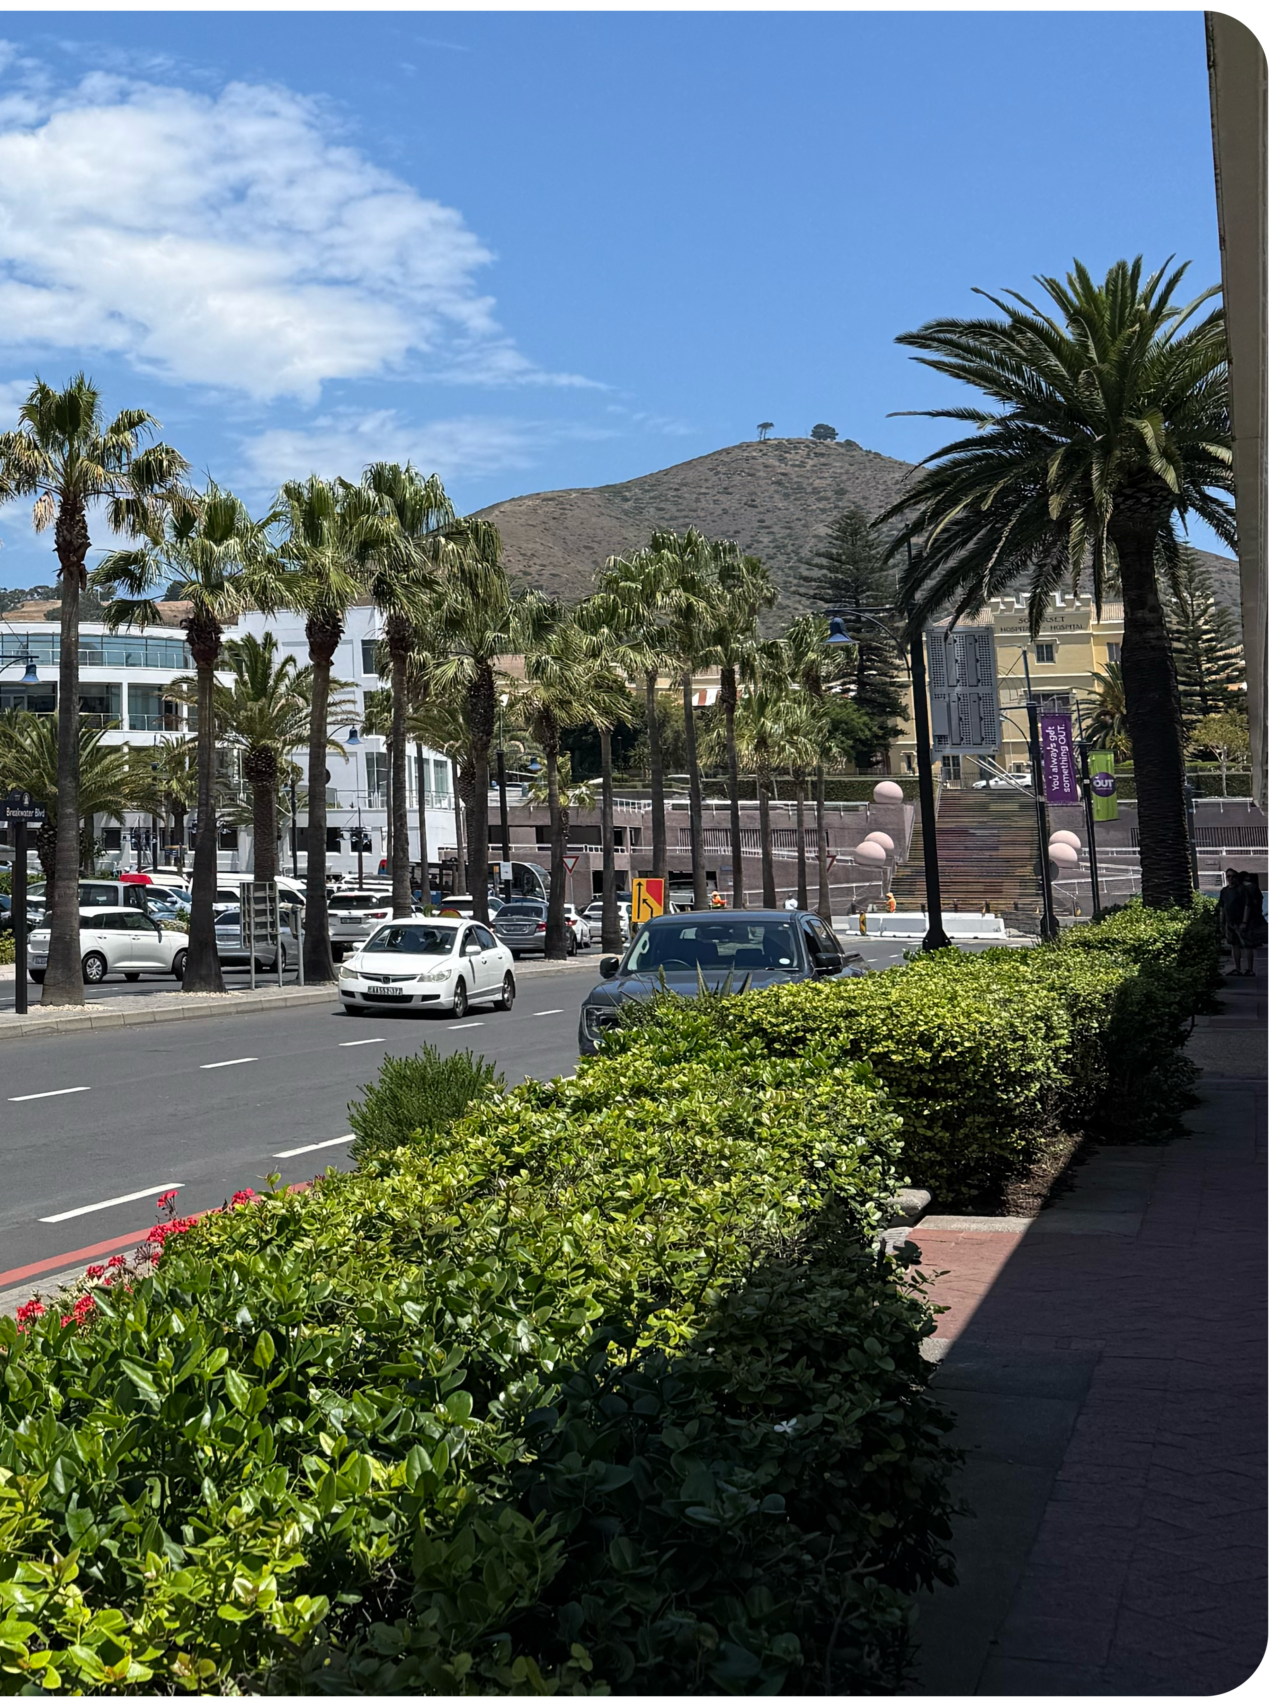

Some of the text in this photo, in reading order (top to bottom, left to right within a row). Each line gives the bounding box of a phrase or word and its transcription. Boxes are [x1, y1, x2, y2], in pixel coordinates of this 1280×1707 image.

[1018, 616, 1066, 624] SORSET
[1049, 743, 1059, 773] always
[1058, 746, 1071, 793] something
[1051, 775, 1060, 791] You
[1093, 779, 1114, 788] OUT
[6, 807, 45, 817] Breakwater Blvd
